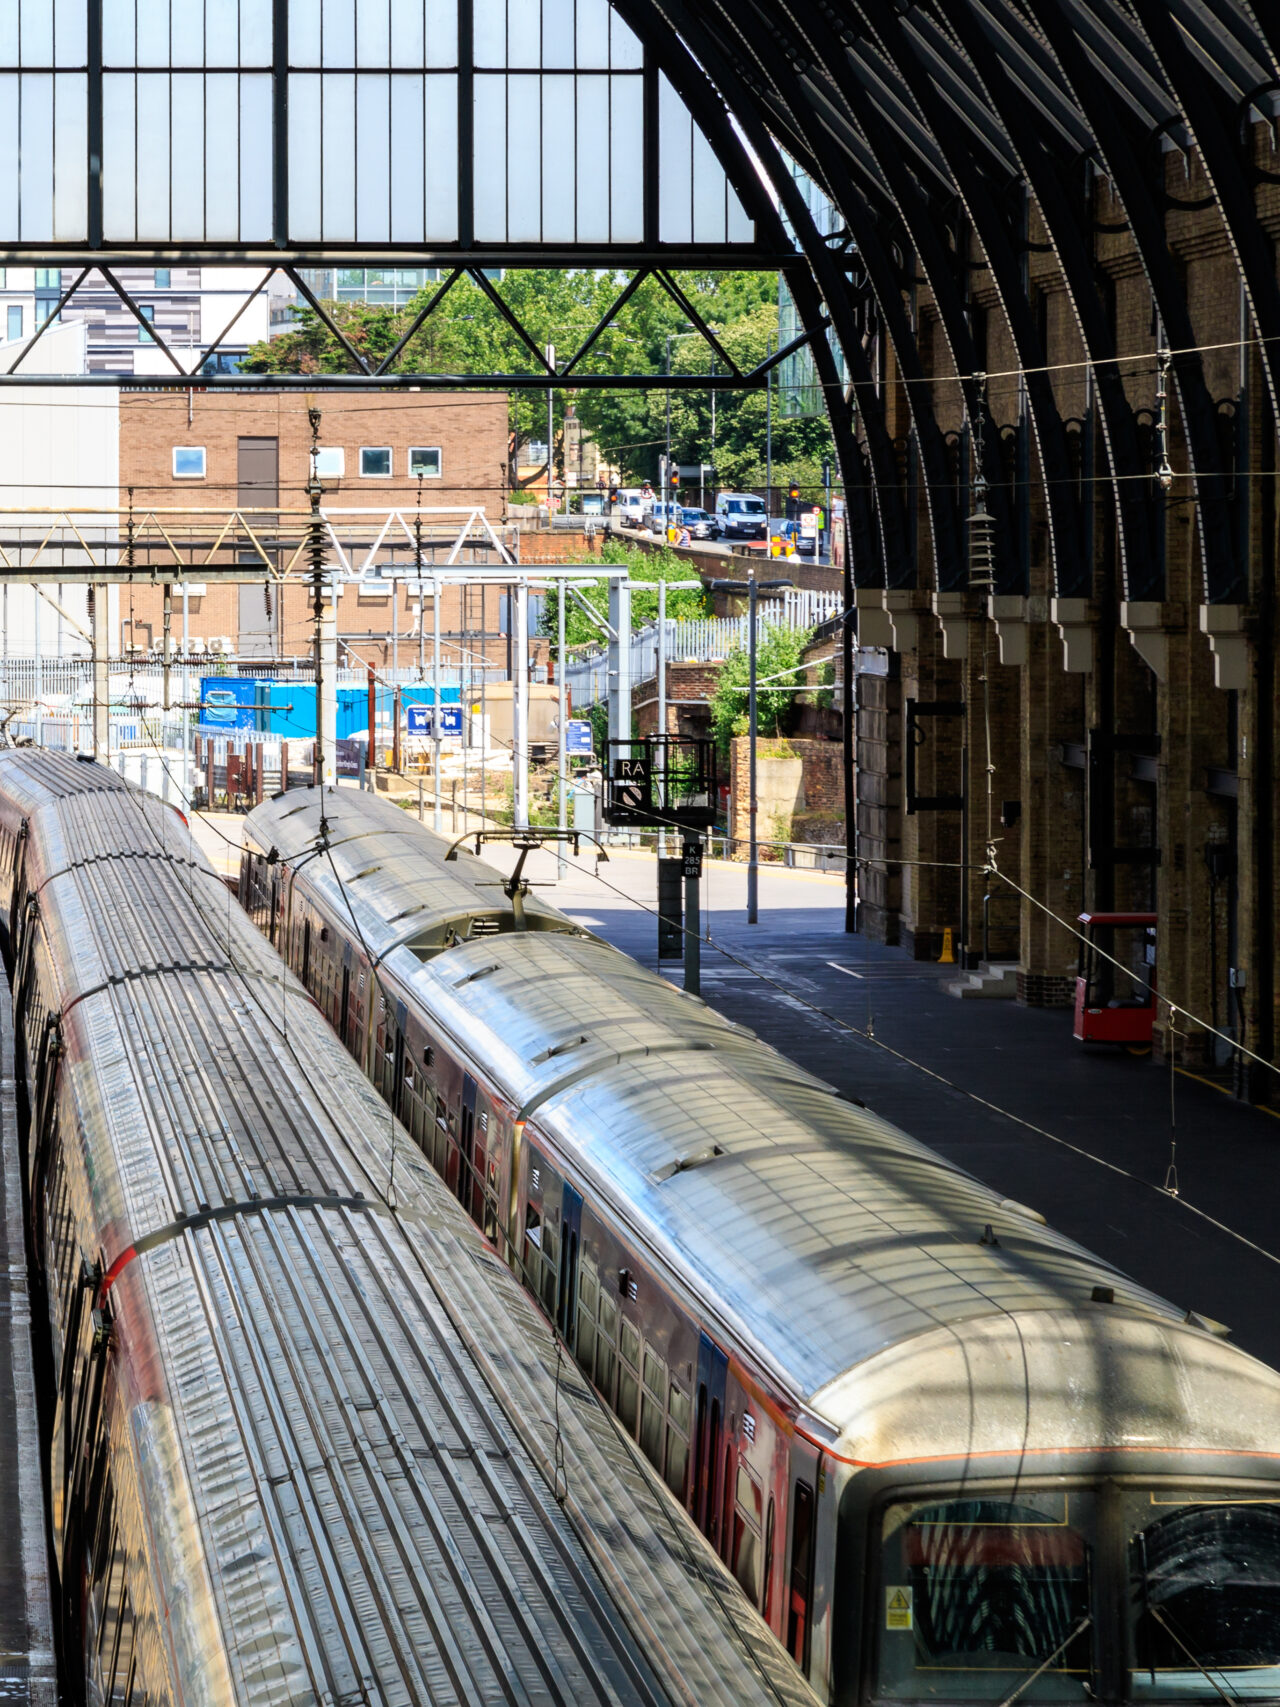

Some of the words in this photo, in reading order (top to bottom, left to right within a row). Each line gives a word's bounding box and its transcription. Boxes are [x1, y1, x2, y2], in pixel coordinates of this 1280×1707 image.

[621, 761, 645, 776] RA
[689, 846, 696, 854] K
[684, 856, 700, 865] 285
[685, 867, 698, 875] BR
